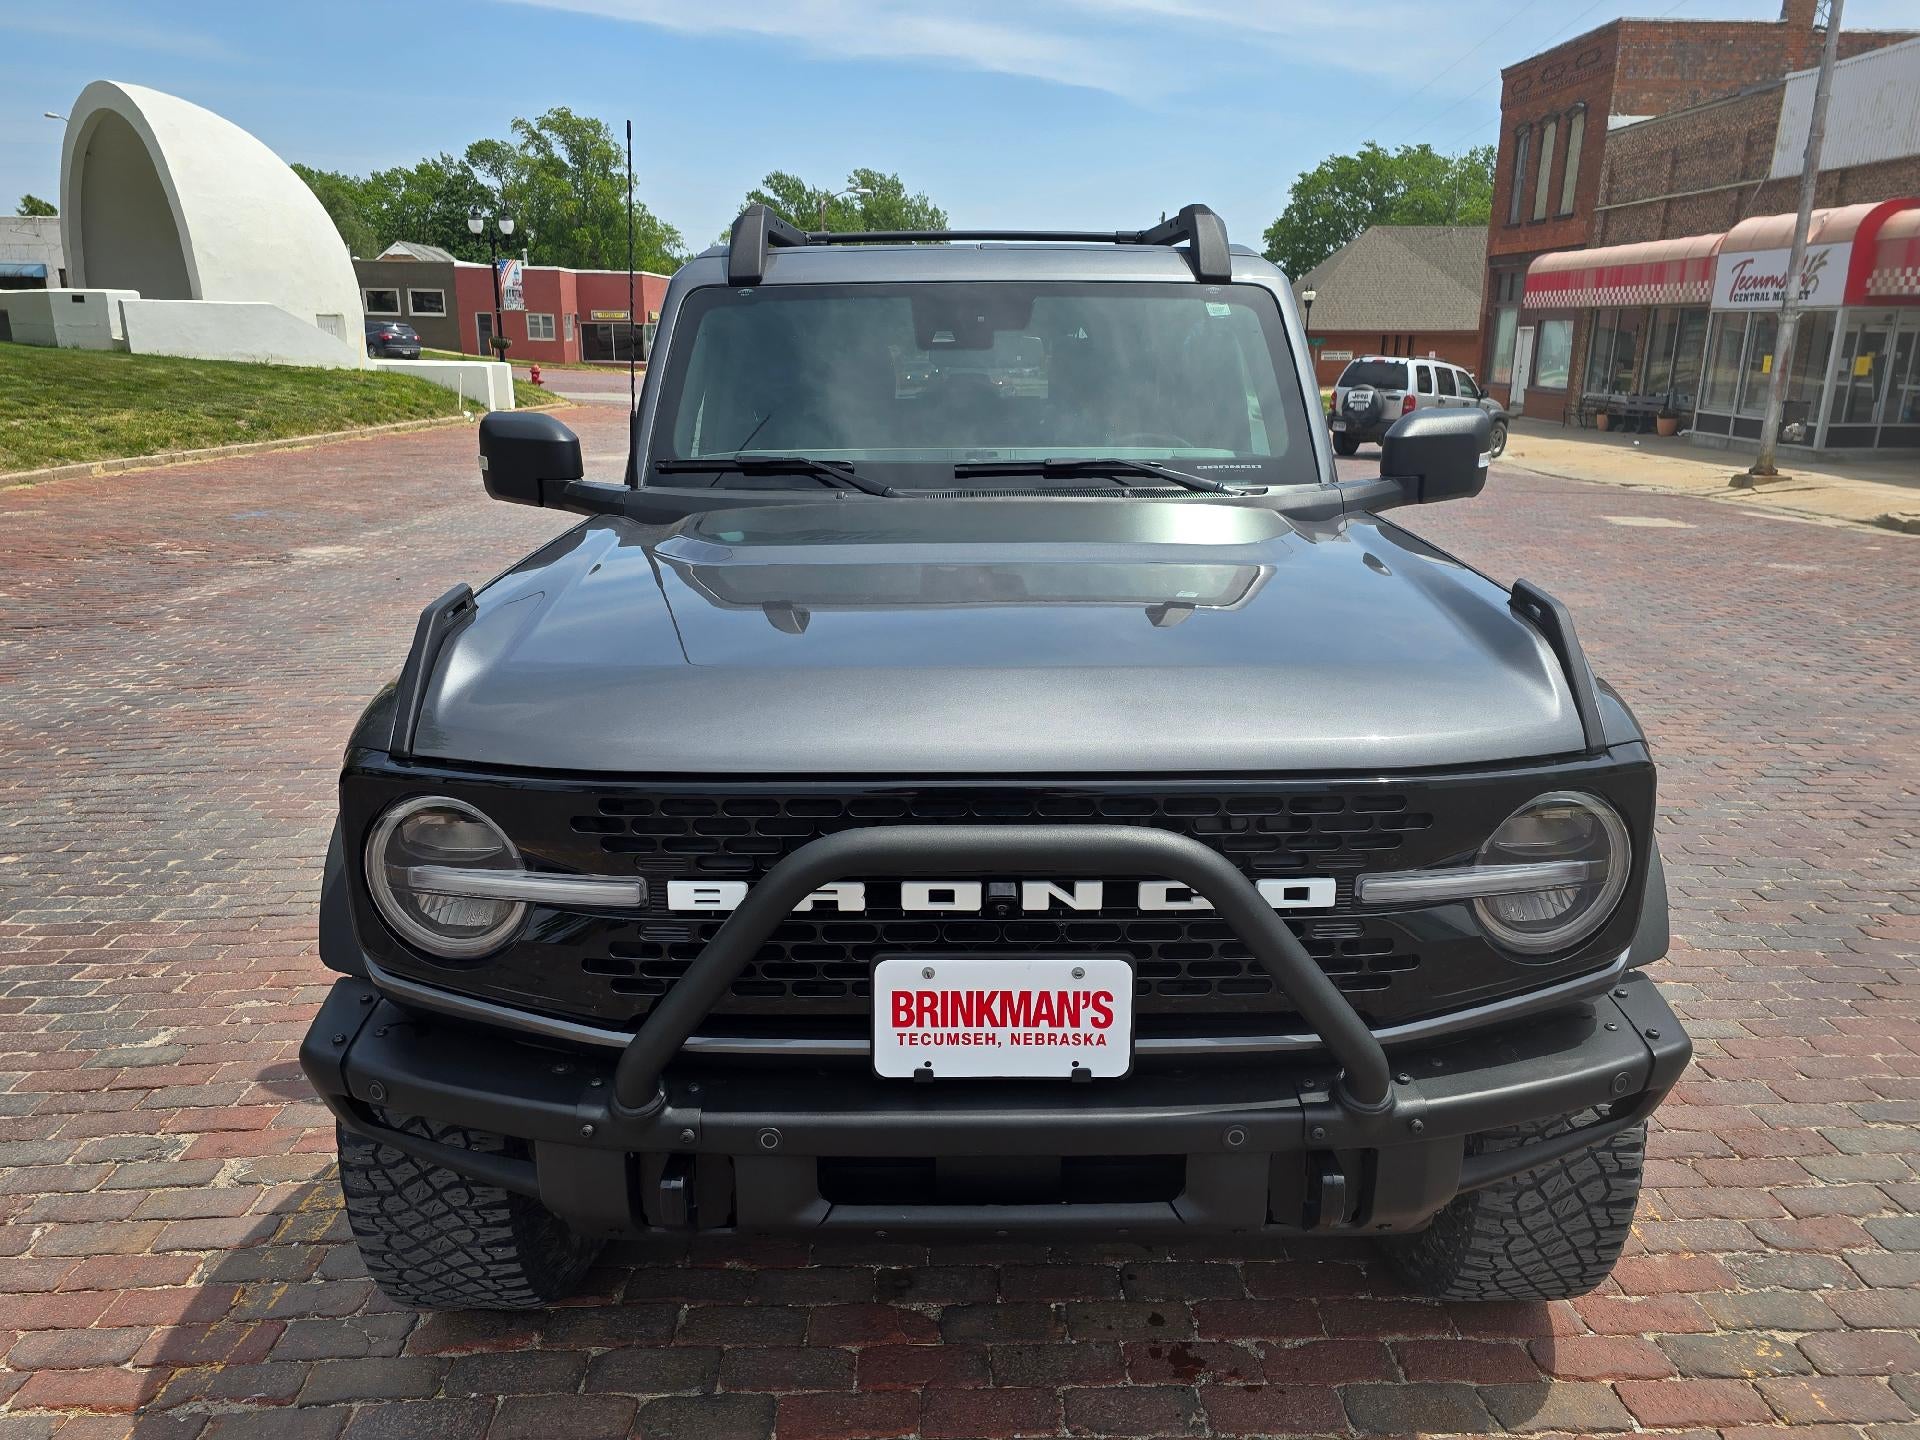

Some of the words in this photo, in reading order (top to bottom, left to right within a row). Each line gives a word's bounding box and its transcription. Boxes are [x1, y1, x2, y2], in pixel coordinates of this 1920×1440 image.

[1729, 254, 1809, 302] Tecumsh
[1734, 290, 1770, 302] CENTRAL
[1772, 289, 1811, 301] MAET
[1352, 392, 1369, 400] Jeep
[667, 877, 1337, 912] BRONCO
[891, 990, 1114, 1029] BRINKMAN'S
[896, 1033, 1002, 1048] TECUMSEH,
[1010, 1033, 1107, 1046] NEBRASKA
